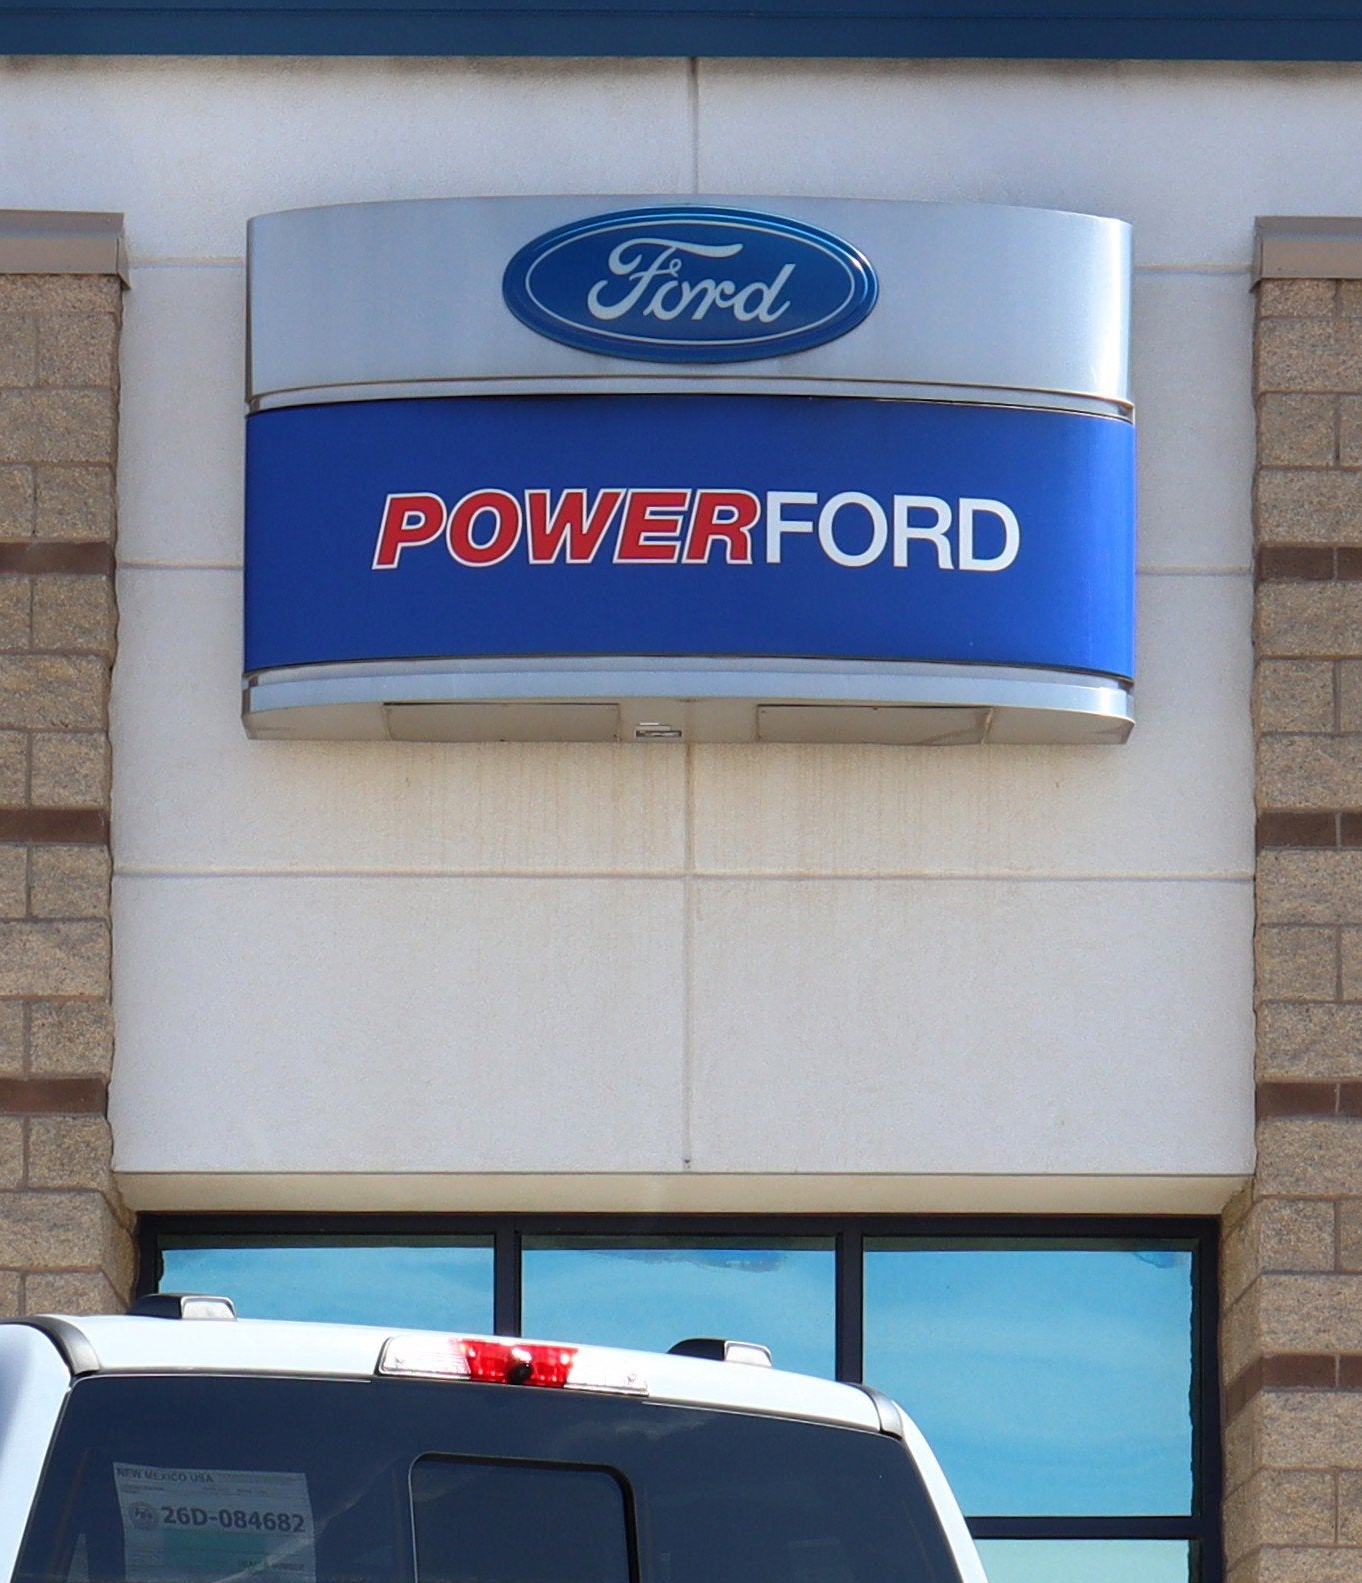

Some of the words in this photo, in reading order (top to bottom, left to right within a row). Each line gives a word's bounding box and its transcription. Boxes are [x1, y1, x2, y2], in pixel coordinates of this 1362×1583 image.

[587, 237, 794, 324] Ford
[144, 1470, 188, 1483] MEXICO
[190, 1474, 214, 1483] USA
[161, 1506, 306, 1533] 26D-084682
